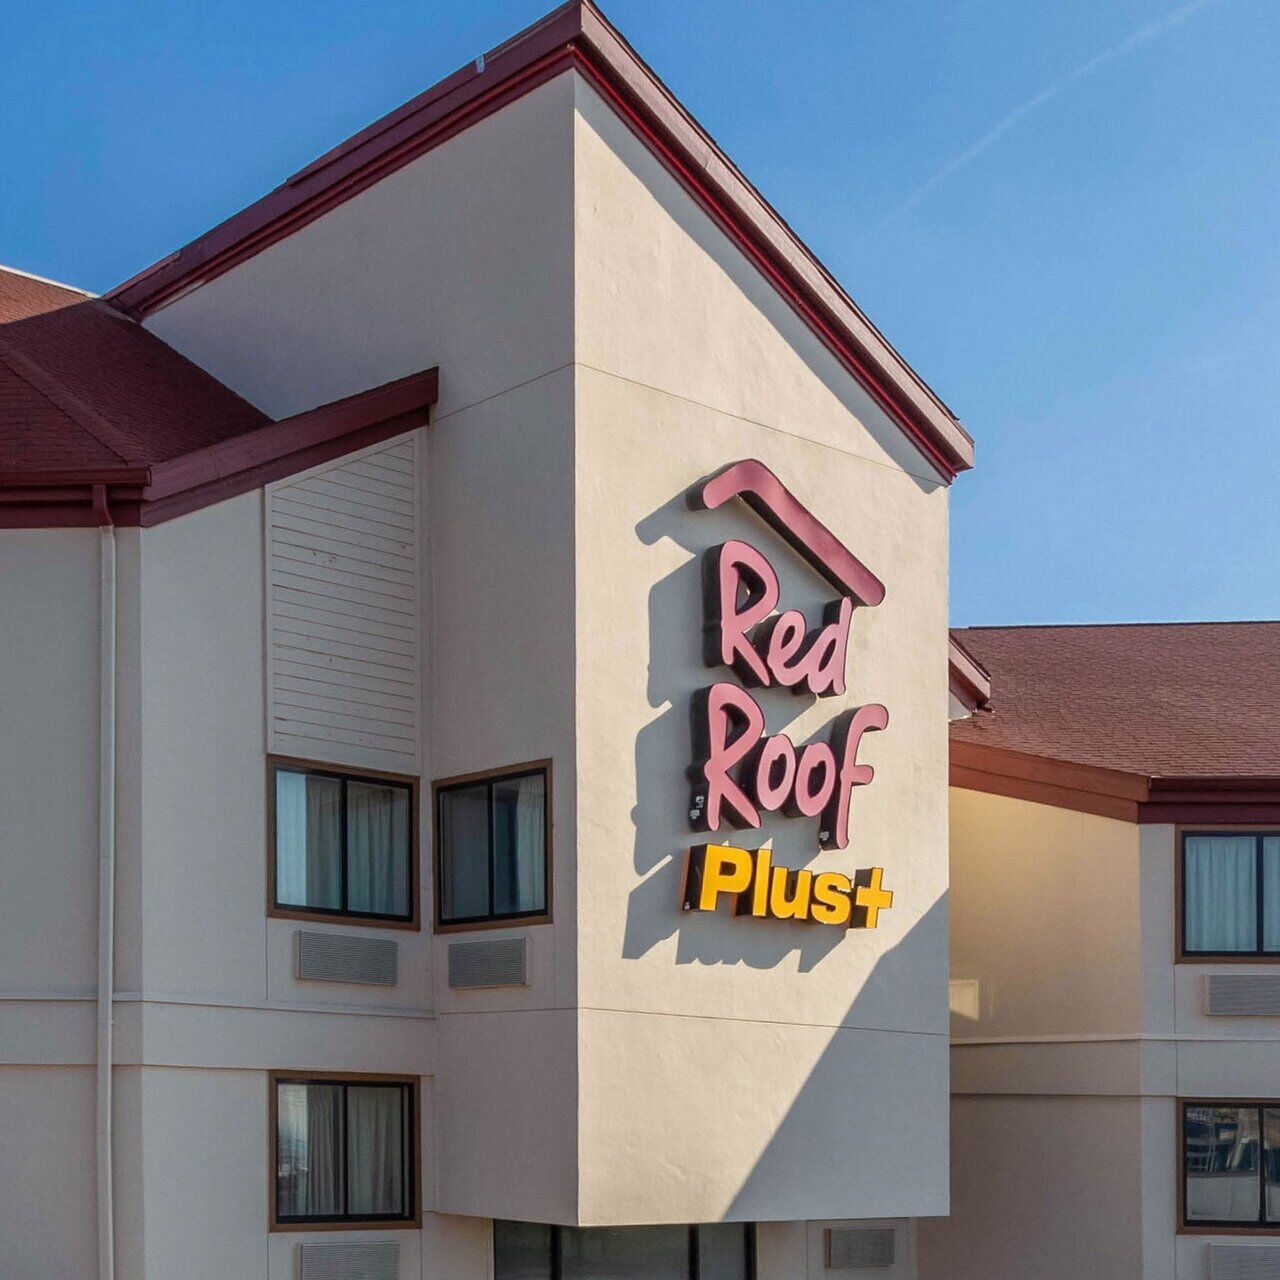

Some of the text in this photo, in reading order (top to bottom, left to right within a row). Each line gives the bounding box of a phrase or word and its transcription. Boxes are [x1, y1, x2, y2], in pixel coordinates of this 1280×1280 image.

[718, 539, 853, 695] Red
[704, 682, 889, 850] Roof
[699, 843, 894, 929] Plus+
